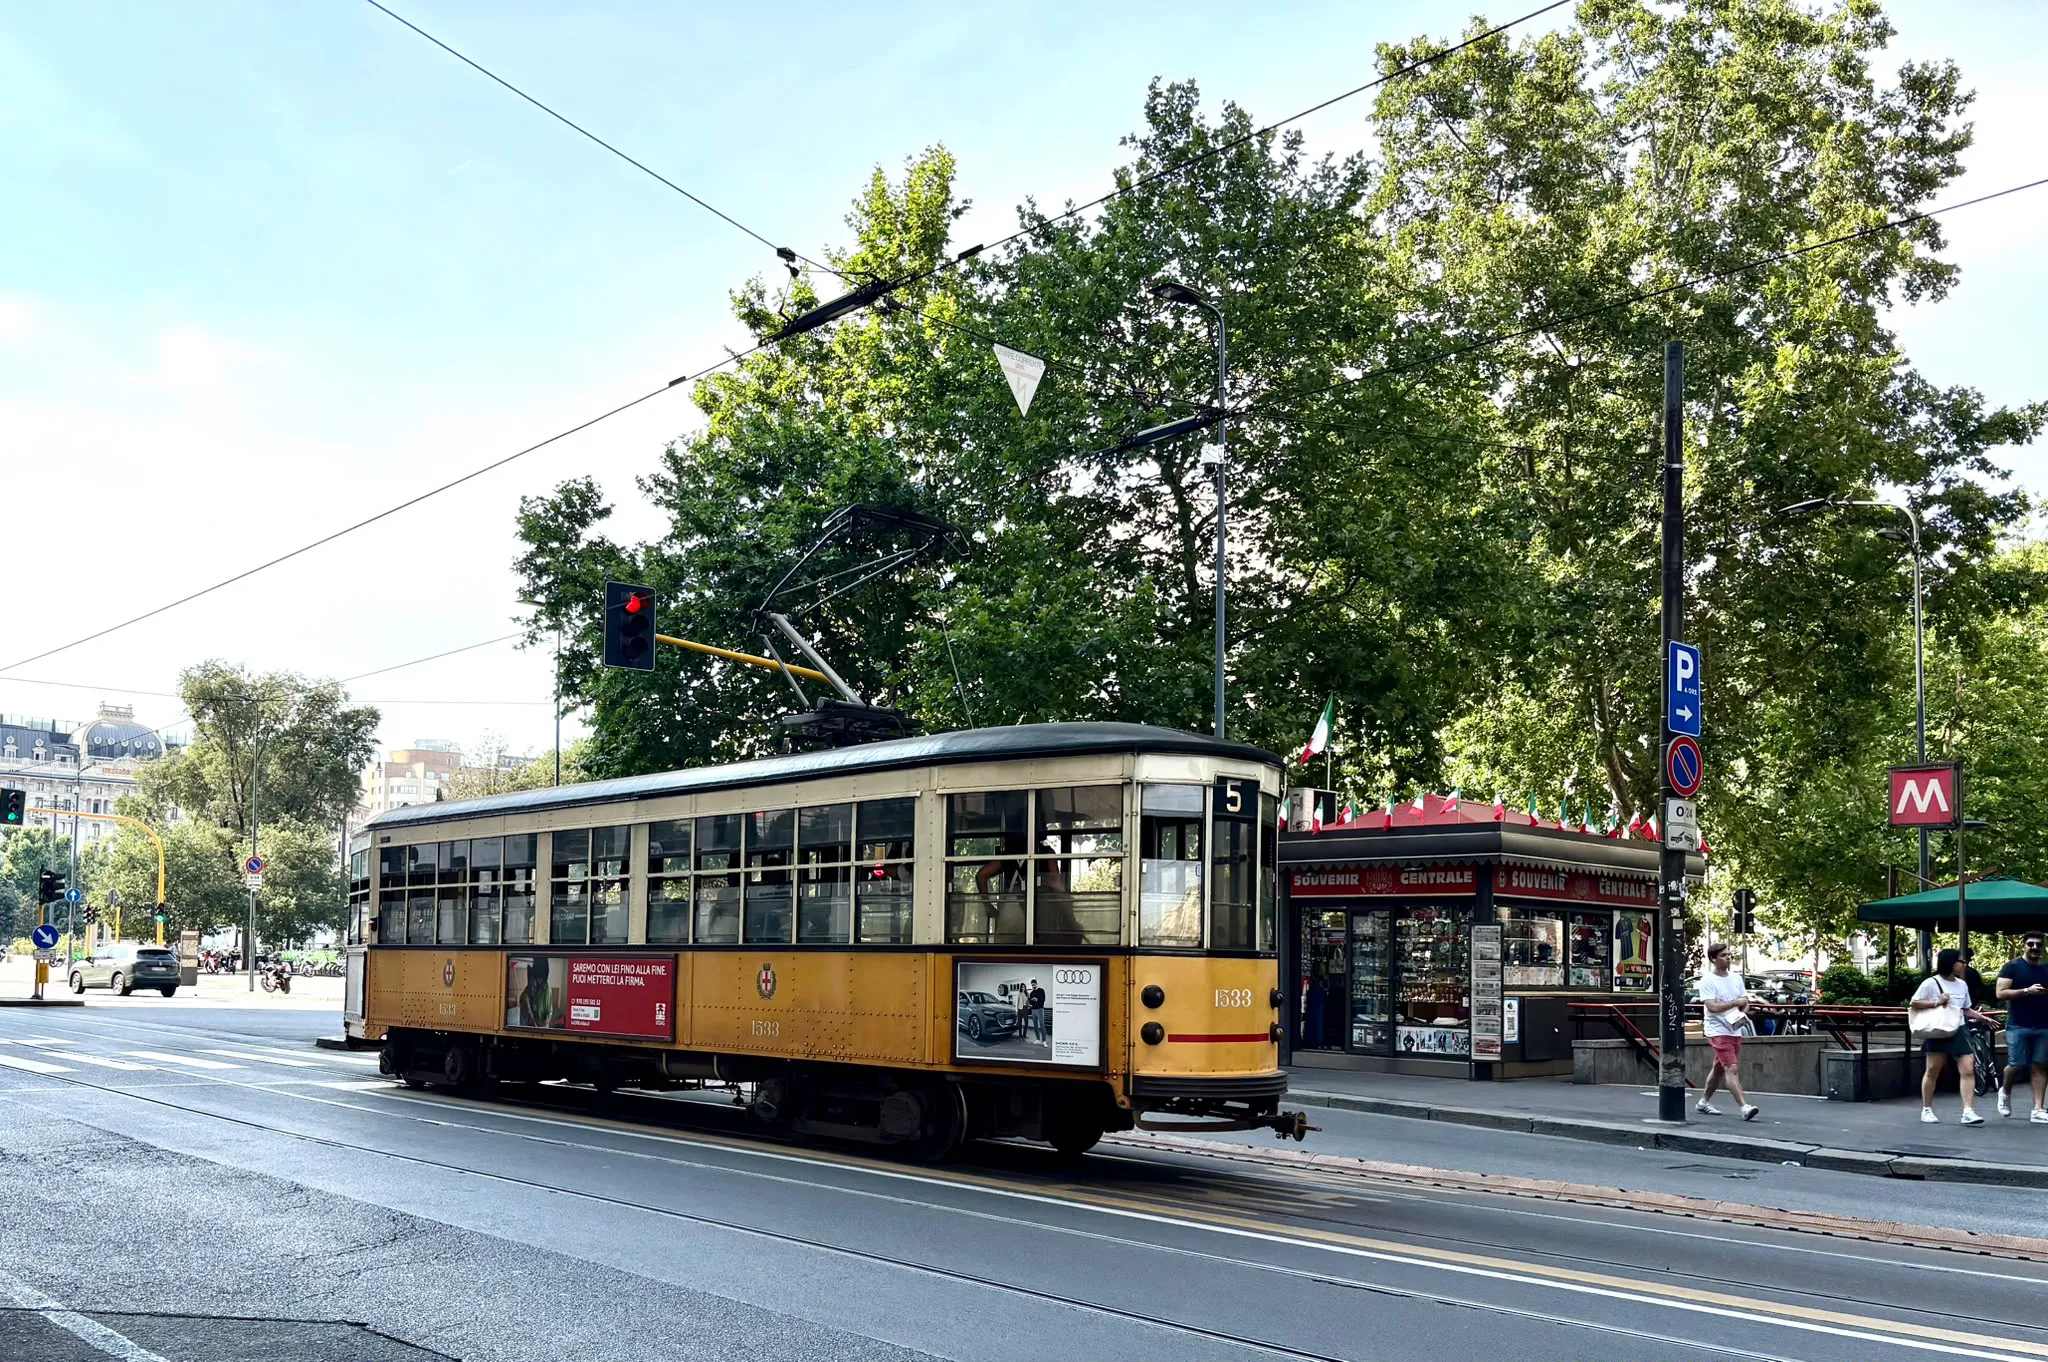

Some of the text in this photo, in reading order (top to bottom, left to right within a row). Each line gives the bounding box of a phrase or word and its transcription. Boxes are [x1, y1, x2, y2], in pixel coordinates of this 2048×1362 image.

[1676, 649, 1694, 692] P
[1226, 779, 1242, 813] 5
[1895, 778, 1949, 814] M
[1293, 871, 1473, 887] SOUVENIR CENTRALE
[1511, 871, 1565, 891] SOUVENIR
[1599, 879, 1646, 898] CENTRALE
[572, 963, 667, 976] SAREMO CON LEI FINO ALLA FINE.
[572, 974, 646, 987] PUOI METTERCI LA FIRMA.
[1215, 988, 1252, 1008] 1533
[751, 1020, 780, 1037] 1533
